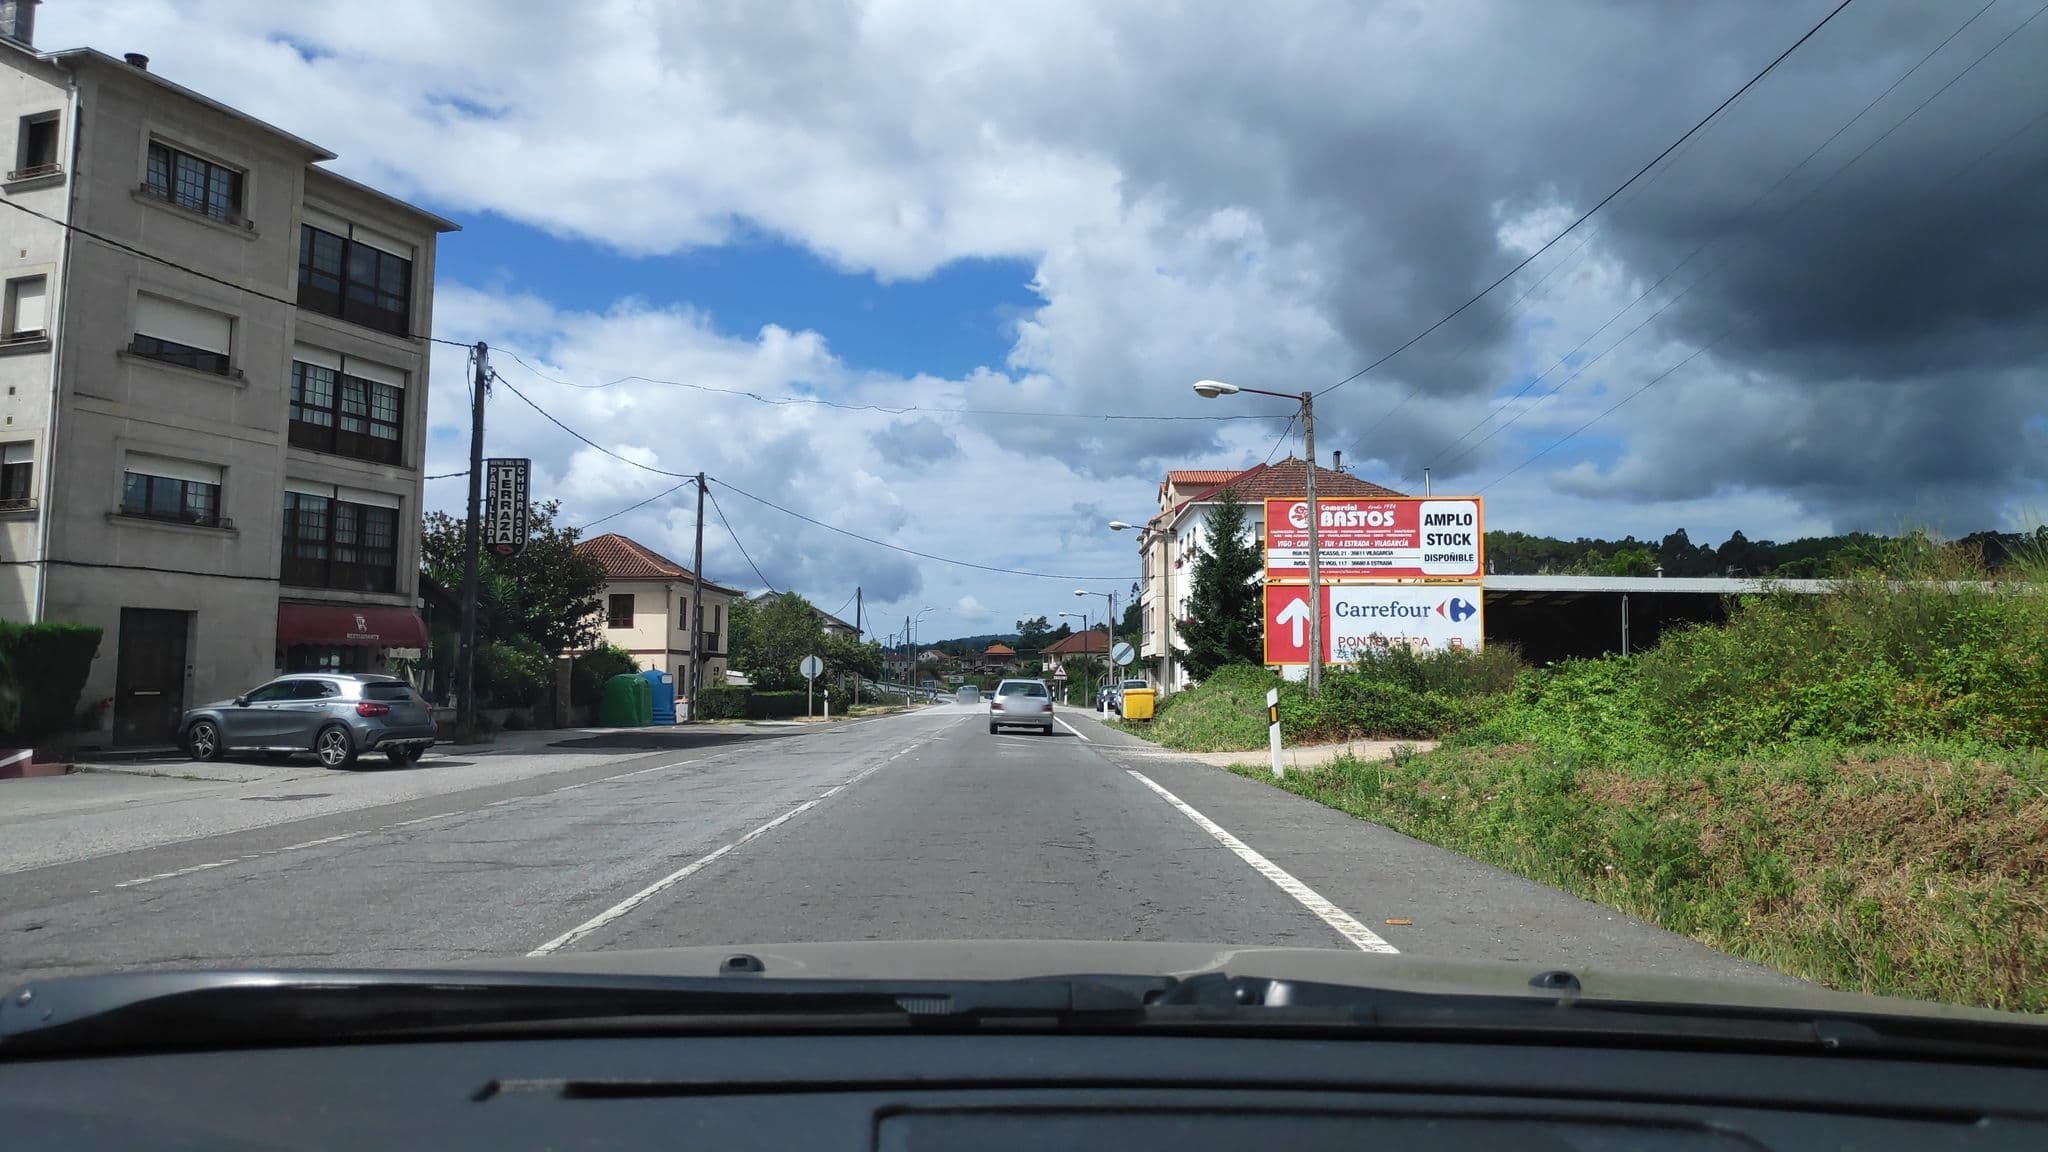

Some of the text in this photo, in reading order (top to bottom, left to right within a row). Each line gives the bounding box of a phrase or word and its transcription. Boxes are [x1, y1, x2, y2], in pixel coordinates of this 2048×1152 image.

[487, 467, 497, 544] PARRILLADA
[499, 468, 513, 542] TERRAZA
[514, 467, 525, 545] CHURRASCO
[1320, 511, 1395, 527] BASTOS
[1424, 513, 1473, 526] AMPLO
[1426, 533, 1472, 546] STOCK
[1336, 601, 1431, 618] Carrefour
